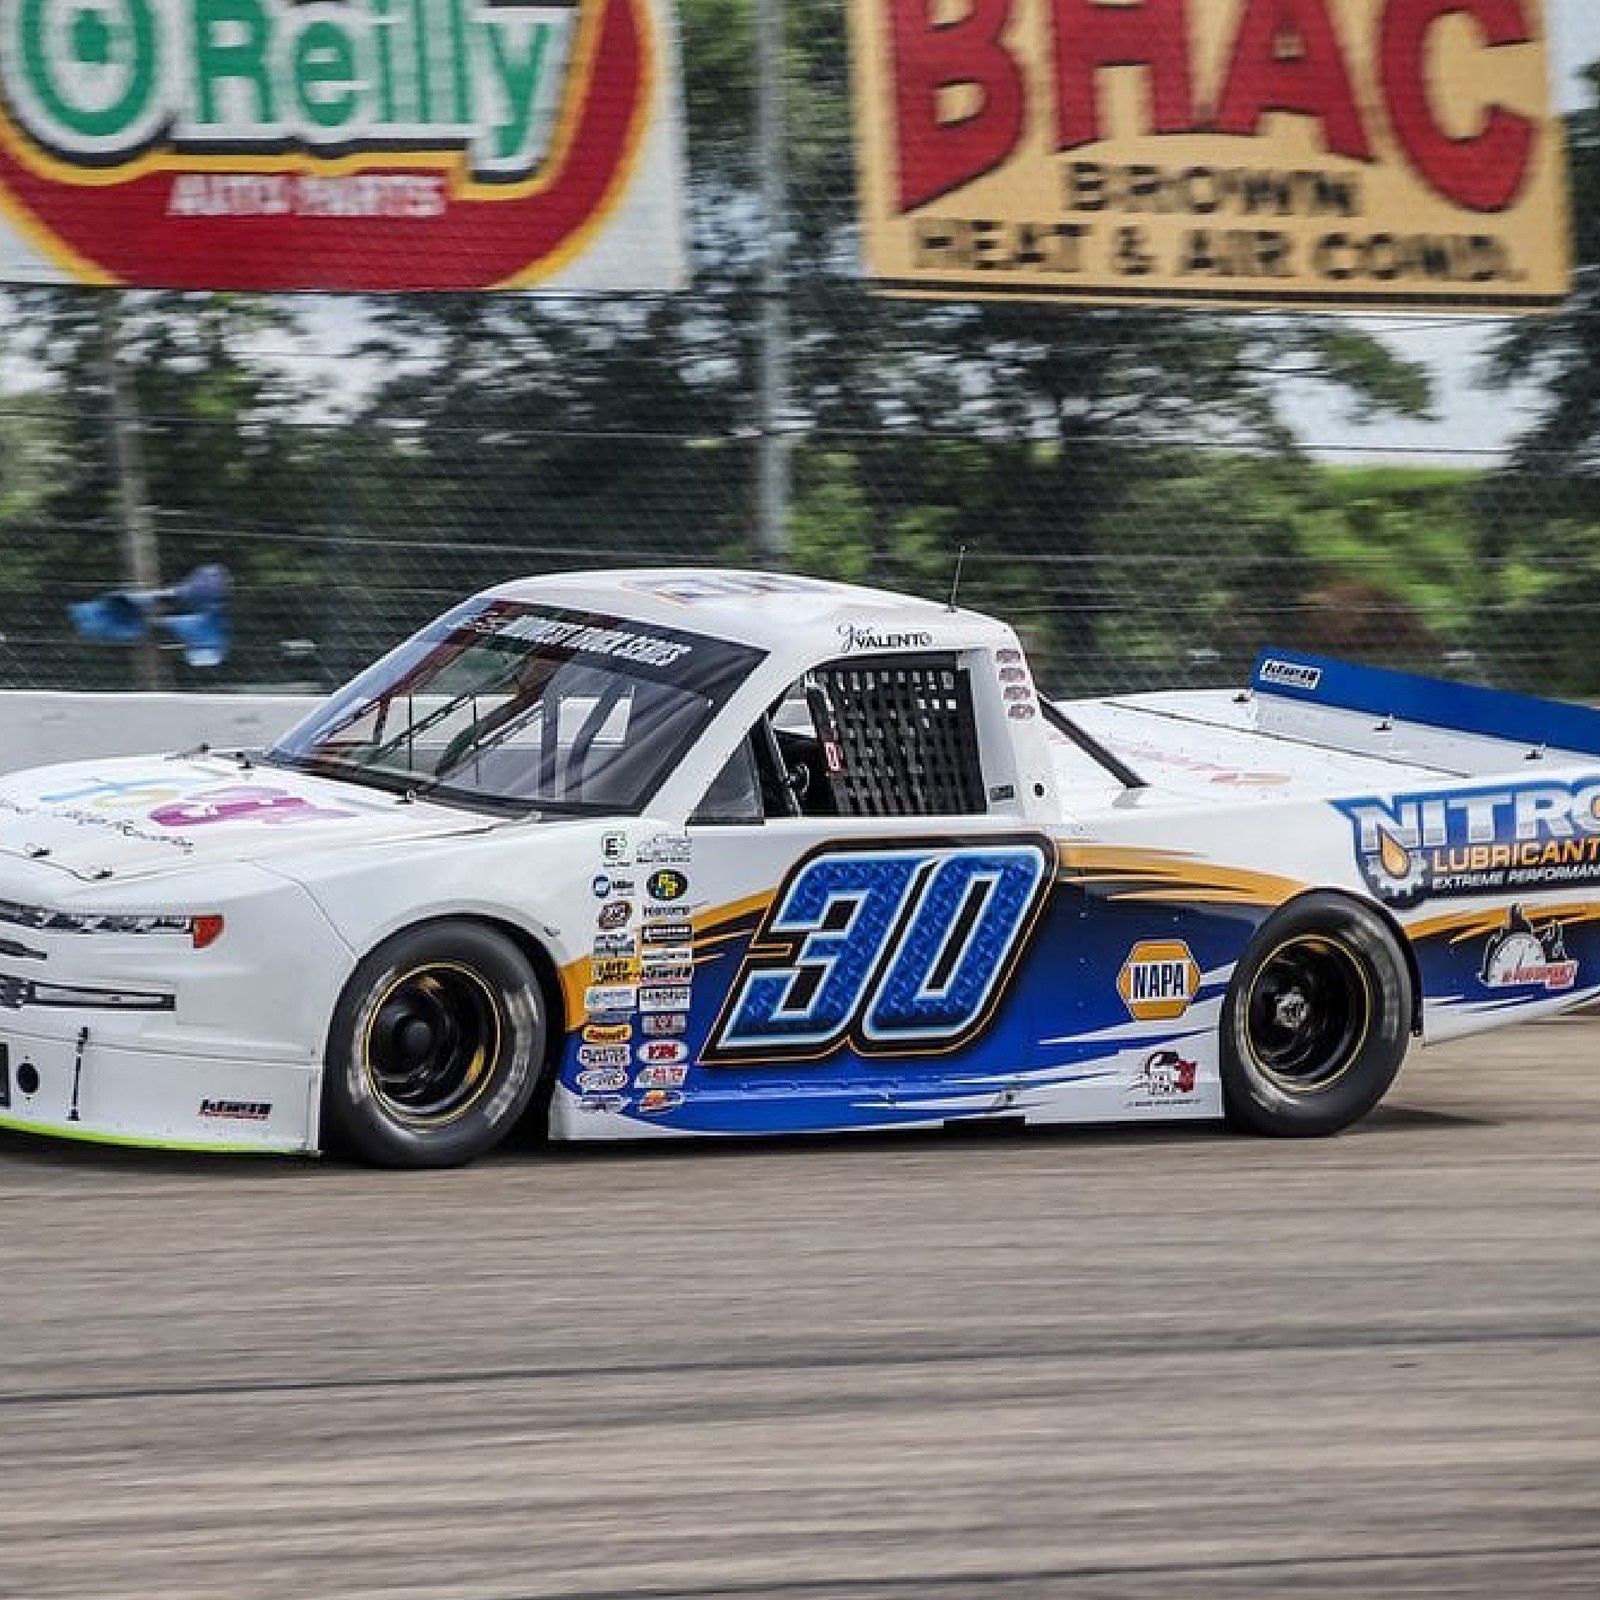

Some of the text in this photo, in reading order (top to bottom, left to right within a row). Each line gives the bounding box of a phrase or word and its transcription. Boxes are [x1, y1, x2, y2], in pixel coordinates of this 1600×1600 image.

[897, 0, 1541, 214] BHAC
[165, 173, 447, 217] AUTO PARTS
[1063, 161, 1363, 217] BROWN
[912, 217, 1092, 274] HEAT
[1109, 225, 1159, 277] &
[1176, 228, 1301, 279] AIR
[716, 842, 1050, 1053] 30
[1132, 963, 1185, 1000] NAPA
